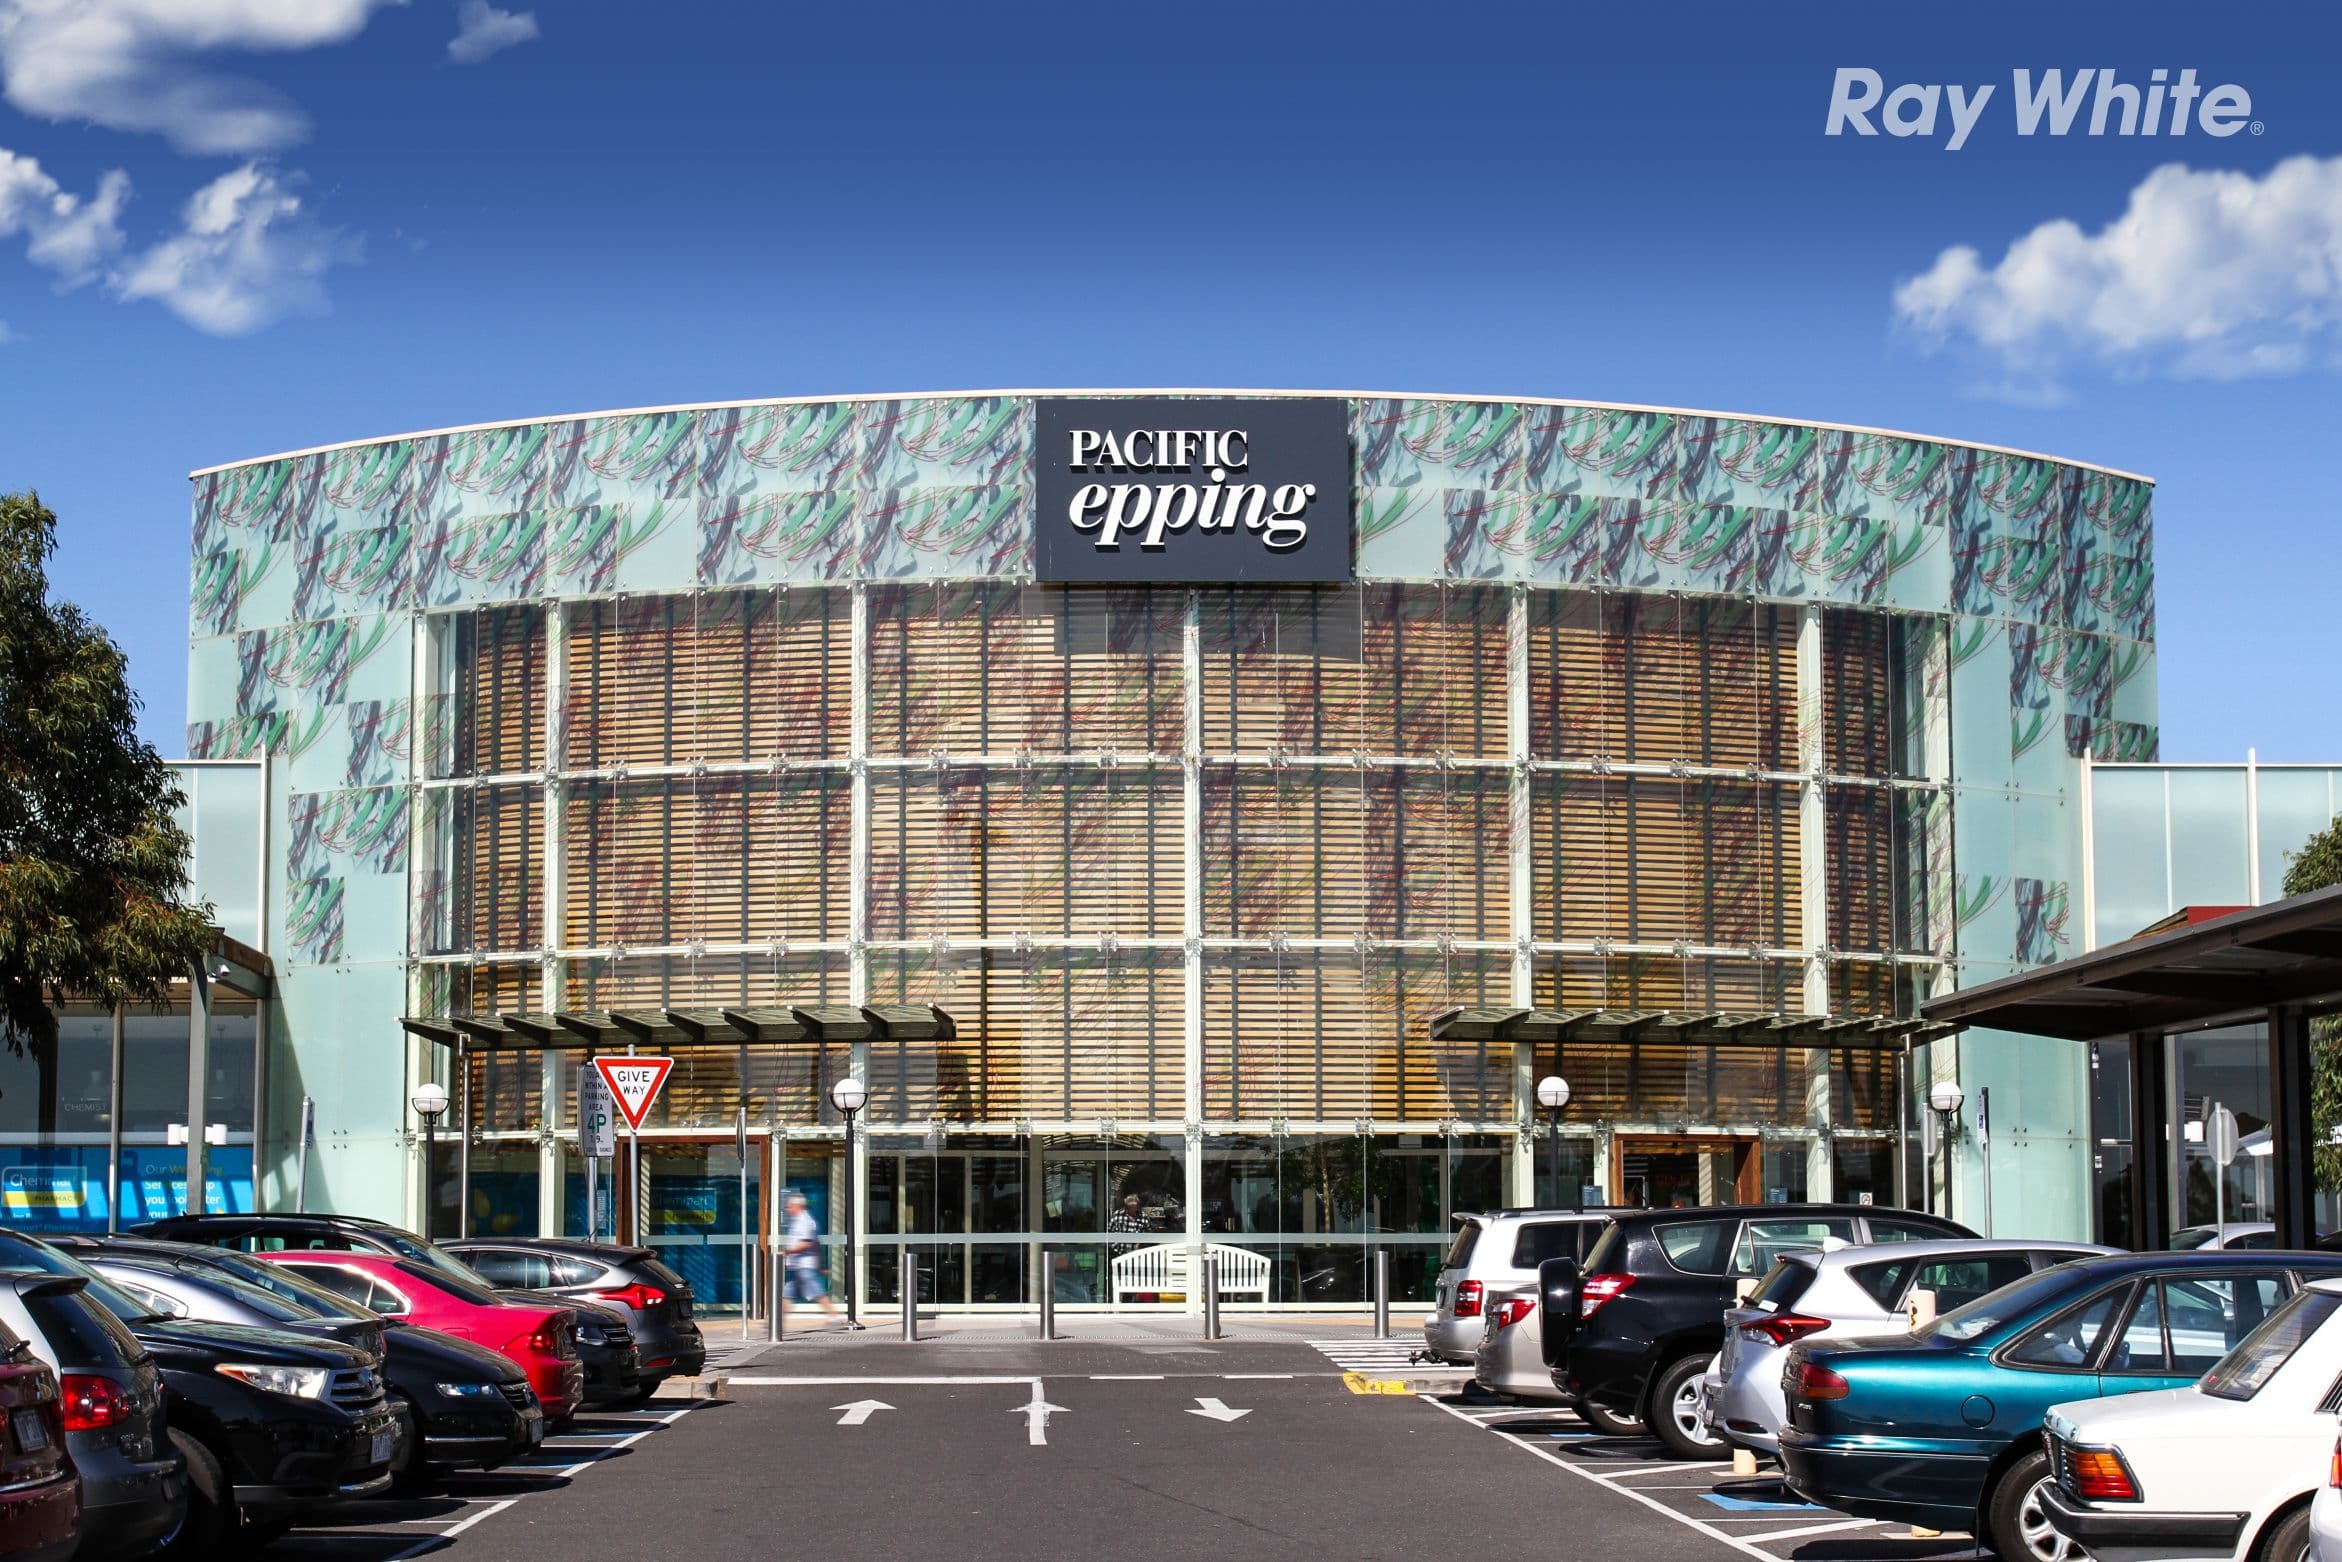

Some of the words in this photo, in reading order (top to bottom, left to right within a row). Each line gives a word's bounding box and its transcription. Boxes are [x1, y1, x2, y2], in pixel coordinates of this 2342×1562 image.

[1068, 429, 1248, 468] PACIFIC
[1068, 468, 1316, 548] epping
[617, 1070, 651, 1083] GIVE
[623, 1085, 646, 1095] WAY
[584, 1092, 609, 1101] PARKING
[588, 1103, 604, 1112] AREA
[586, 1113, 607, 1134] 4P
[145, 1164, 167, 1176] Our
